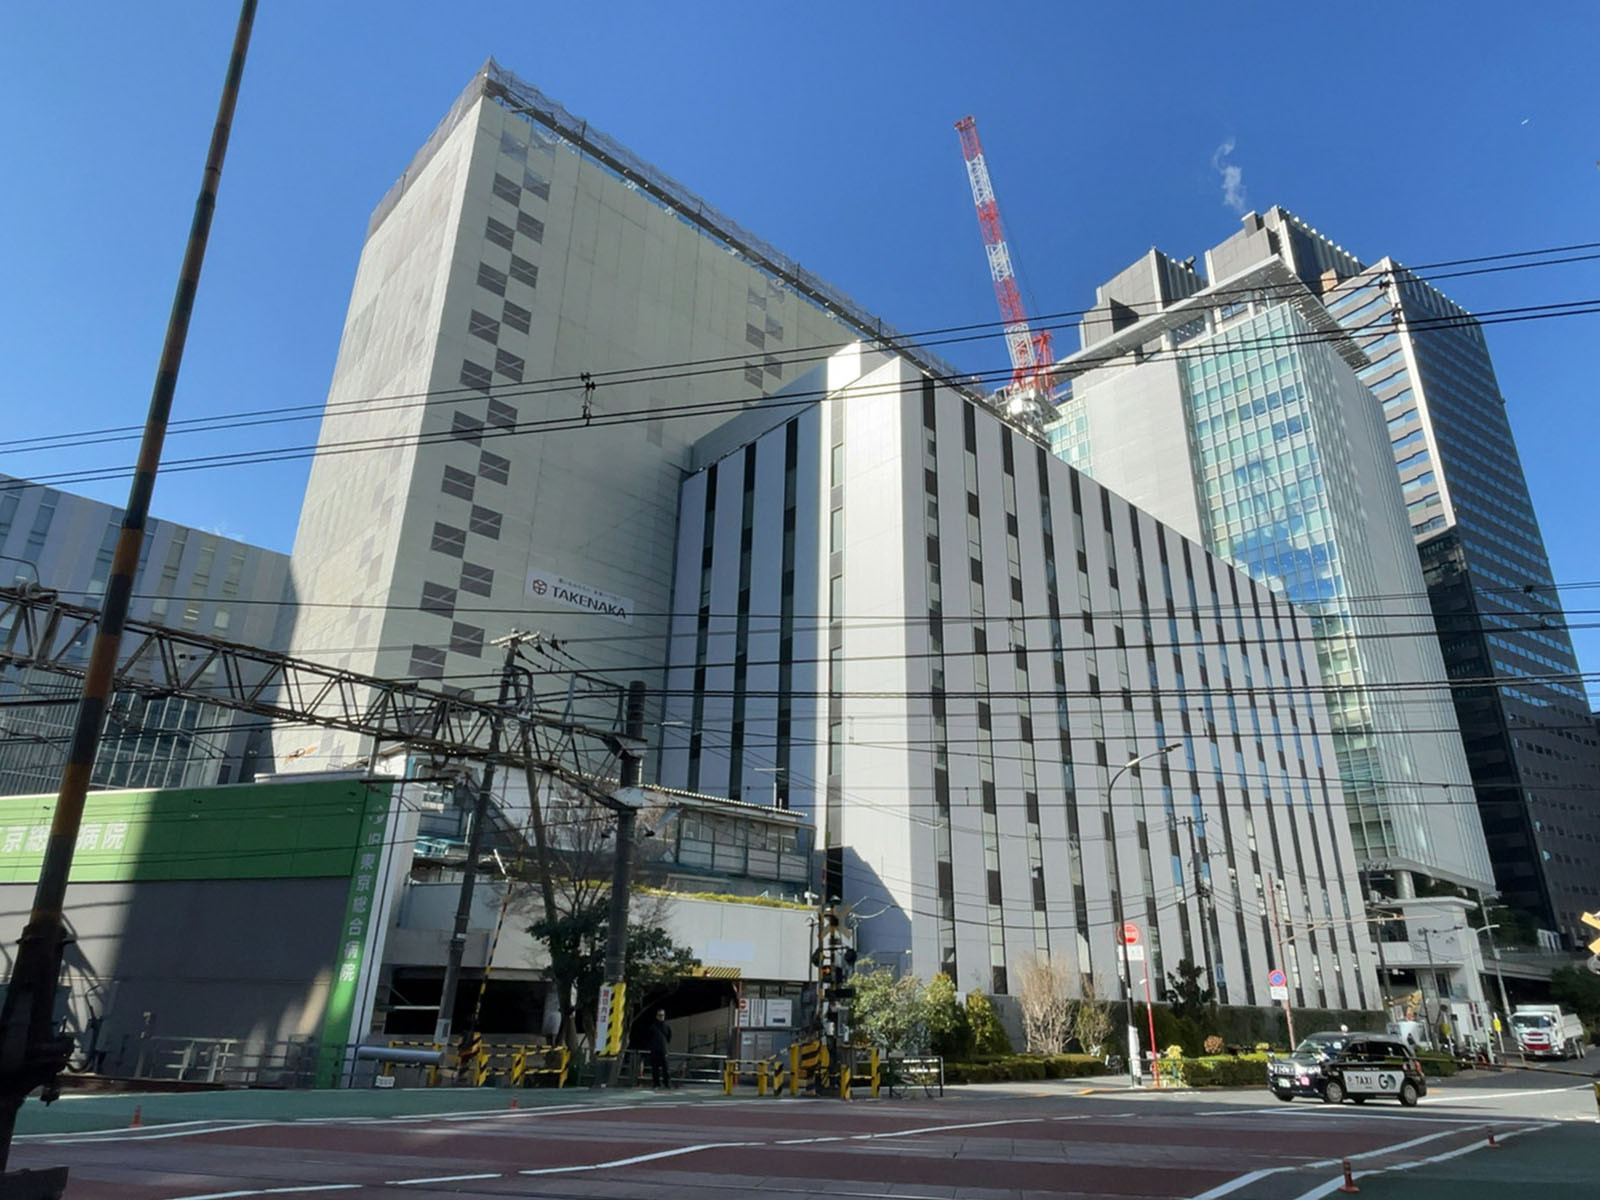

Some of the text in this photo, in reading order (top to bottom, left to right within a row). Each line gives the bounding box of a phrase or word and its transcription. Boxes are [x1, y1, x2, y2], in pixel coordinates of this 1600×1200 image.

[552, 585, 626, 619] TAKENAKA
[1, 823, 128, 852] 京総病院
[1355, 1075, 1372, 1085] TAXI
